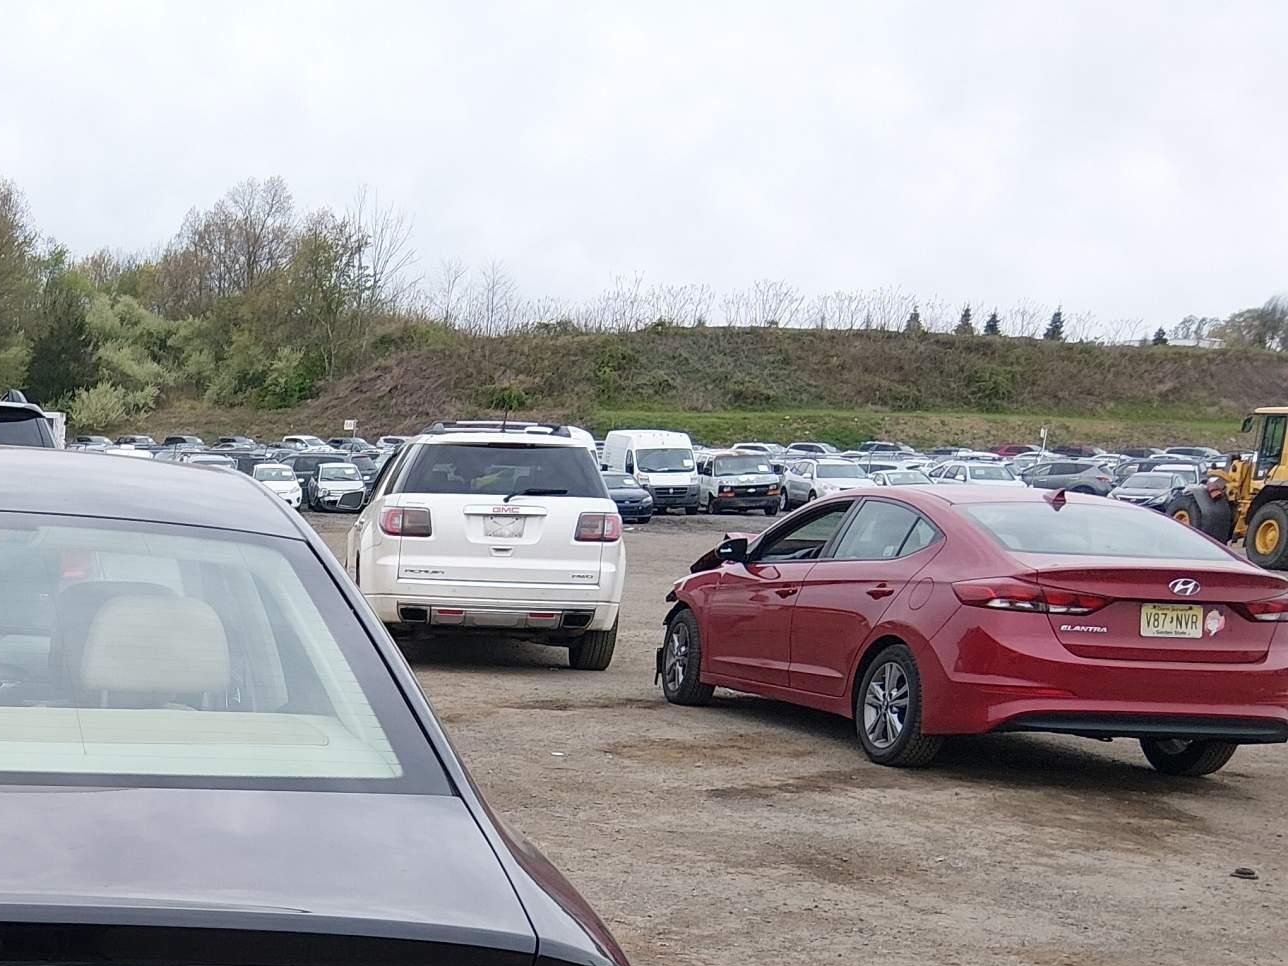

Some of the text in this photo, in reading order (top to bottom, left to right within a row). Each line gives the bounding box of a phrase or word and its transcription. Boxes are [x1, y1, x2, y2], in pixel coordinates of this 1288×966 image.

[1145, 612, 1199, 630] V87 NVR
[1060, 624, 1108, 633] ELANTRA
